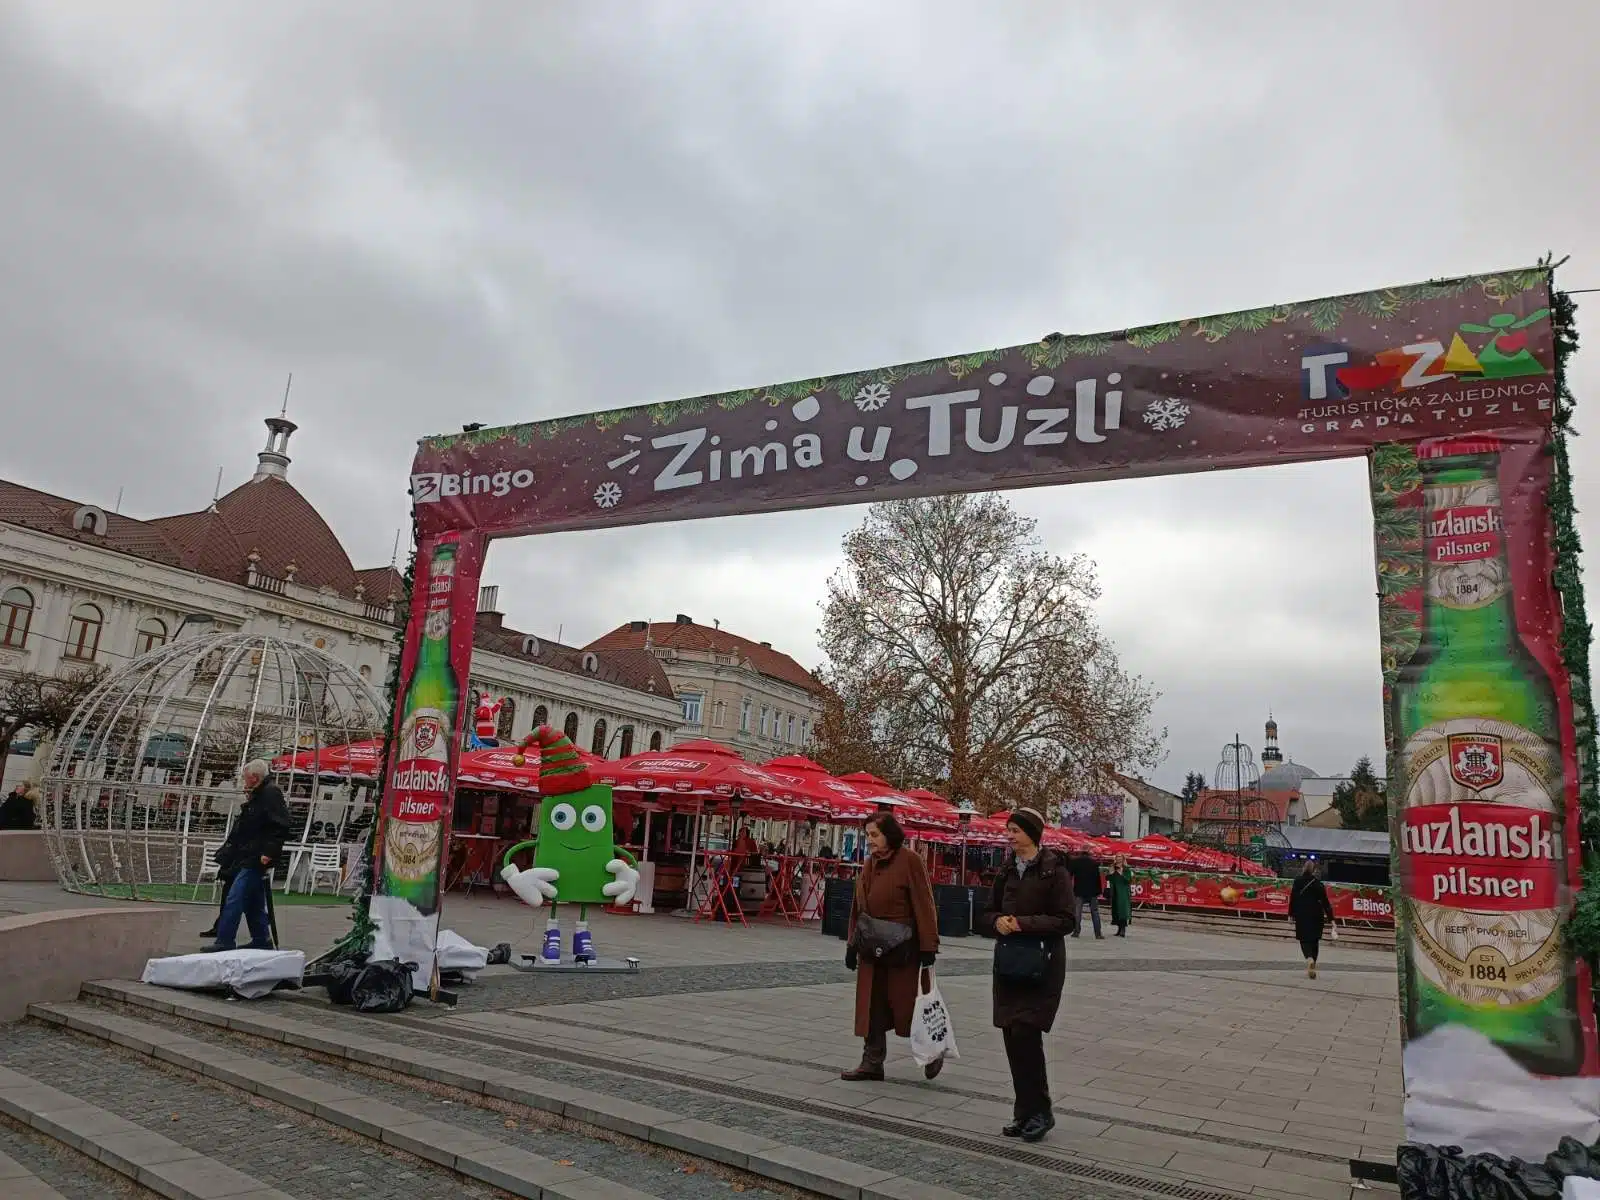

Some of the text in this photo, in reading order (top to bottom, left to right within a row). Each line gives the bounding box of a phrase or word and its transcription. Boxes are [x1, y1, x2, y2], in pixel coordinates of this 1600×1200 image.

[1427, 383, 1551, 406] ZAJEDNICA
[1301, 399, 1552, 434] GRADA TUZLE
[653, 372, 1123, 491] Zima u Tuzli
[440, 468, 534, 497] Bingo
[1436, 540, 1491, 561] pilsner
[398, 795, 435, 818] pilsner
[1401, 805, 1563, 860] tuzlanski
[1432, 866, 1535, 901] pilsner
[1363, 898, 1392, 916] Bingo
[1445, 925, 1528, 938] BEER PIVO BIER
[1468, 963, 1508, 983] 1884
